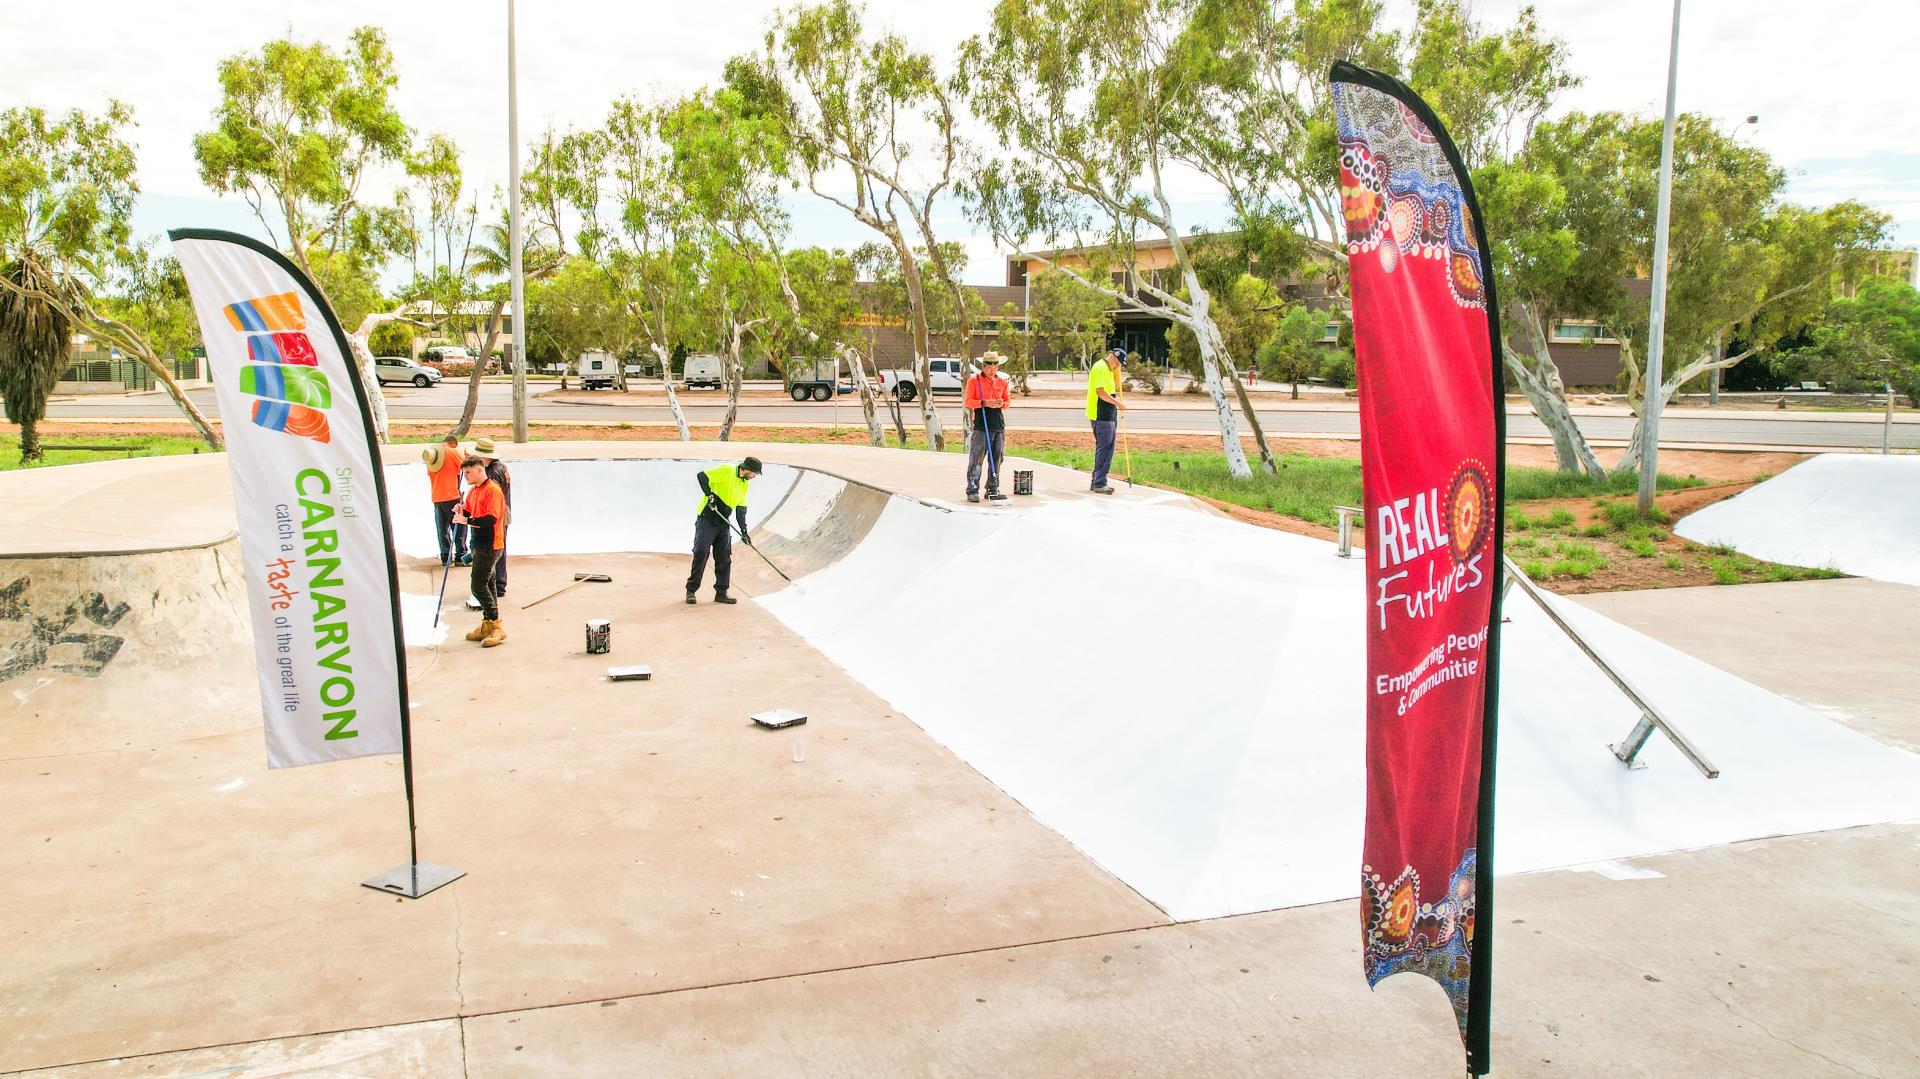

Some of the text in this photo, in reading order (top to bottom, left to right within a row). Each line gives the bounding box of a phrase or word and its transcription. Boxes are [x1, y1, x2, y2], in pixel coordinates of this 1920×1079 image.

[336, 467, 359, 518] Shire of
[1377, 487, 1450, 570] REAL
[265, 503, 300, 712] catch a taste of the great life
[294, 467, 358, 741] CARNARVON
[1376, 552, 1483, 631] Futures
[1376, 643, 1446, 695] Empowering
[1397, 657, 1478, 716] & Communitie
